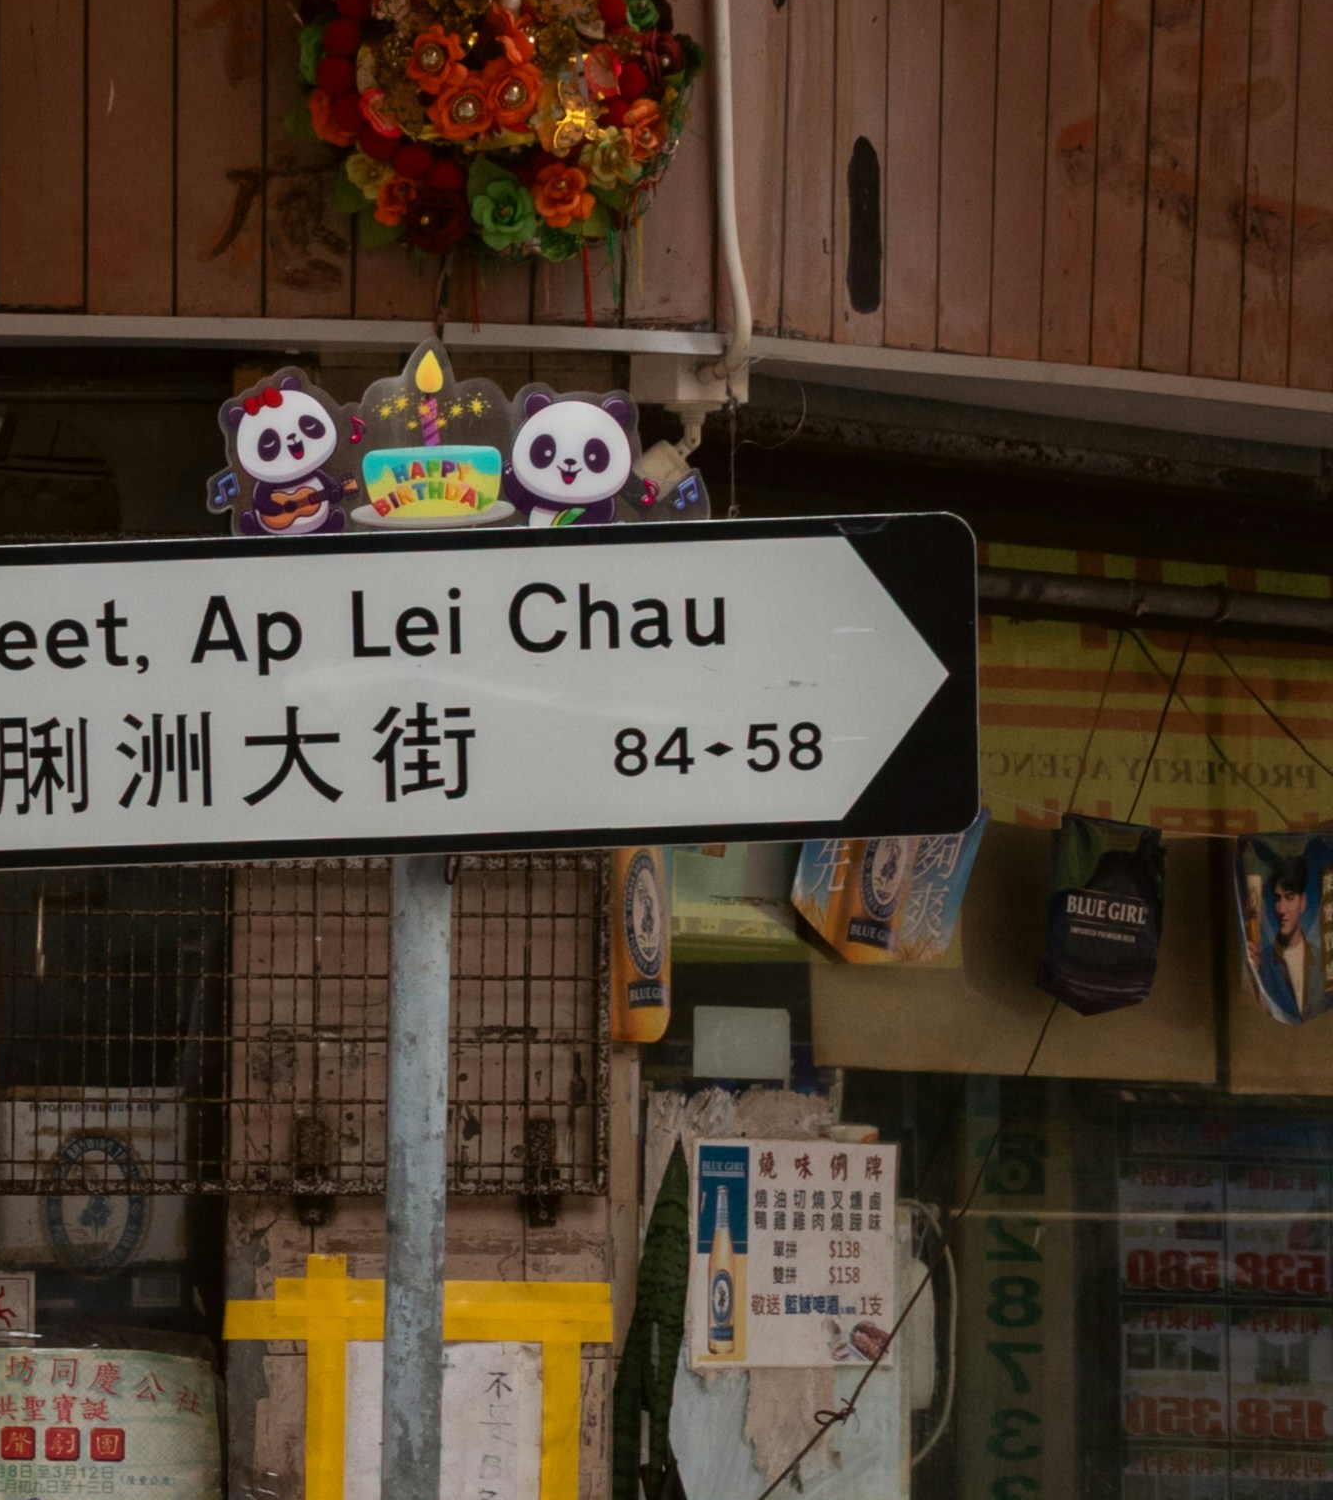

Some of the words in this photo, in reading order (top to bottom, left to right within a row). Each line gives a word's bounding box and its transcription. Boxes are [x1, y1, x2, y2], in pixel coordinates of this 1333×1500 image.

[391, 459, 472, 484] HAPPY
[371, 481, 490, 518] BIRTHDAY
[190, 595, 304, 676] Ap
[351, 587, 463, 658] Lei
[508, 582, 727, 654] Chau
[1066, 894, 1106, 920] BLUE
[1107, 900, 1148, 926] GIRL
[849, 922, 876, 940] BLUE
[629, 986, 652, 1001] BLUE
[702, 1161, 723, 1171] BLUE
[758, 1151, 883, 1182] 燒味例牌
[828, 1240, 861, 1259] $138
[828, 1266, 861, 1285] $158
